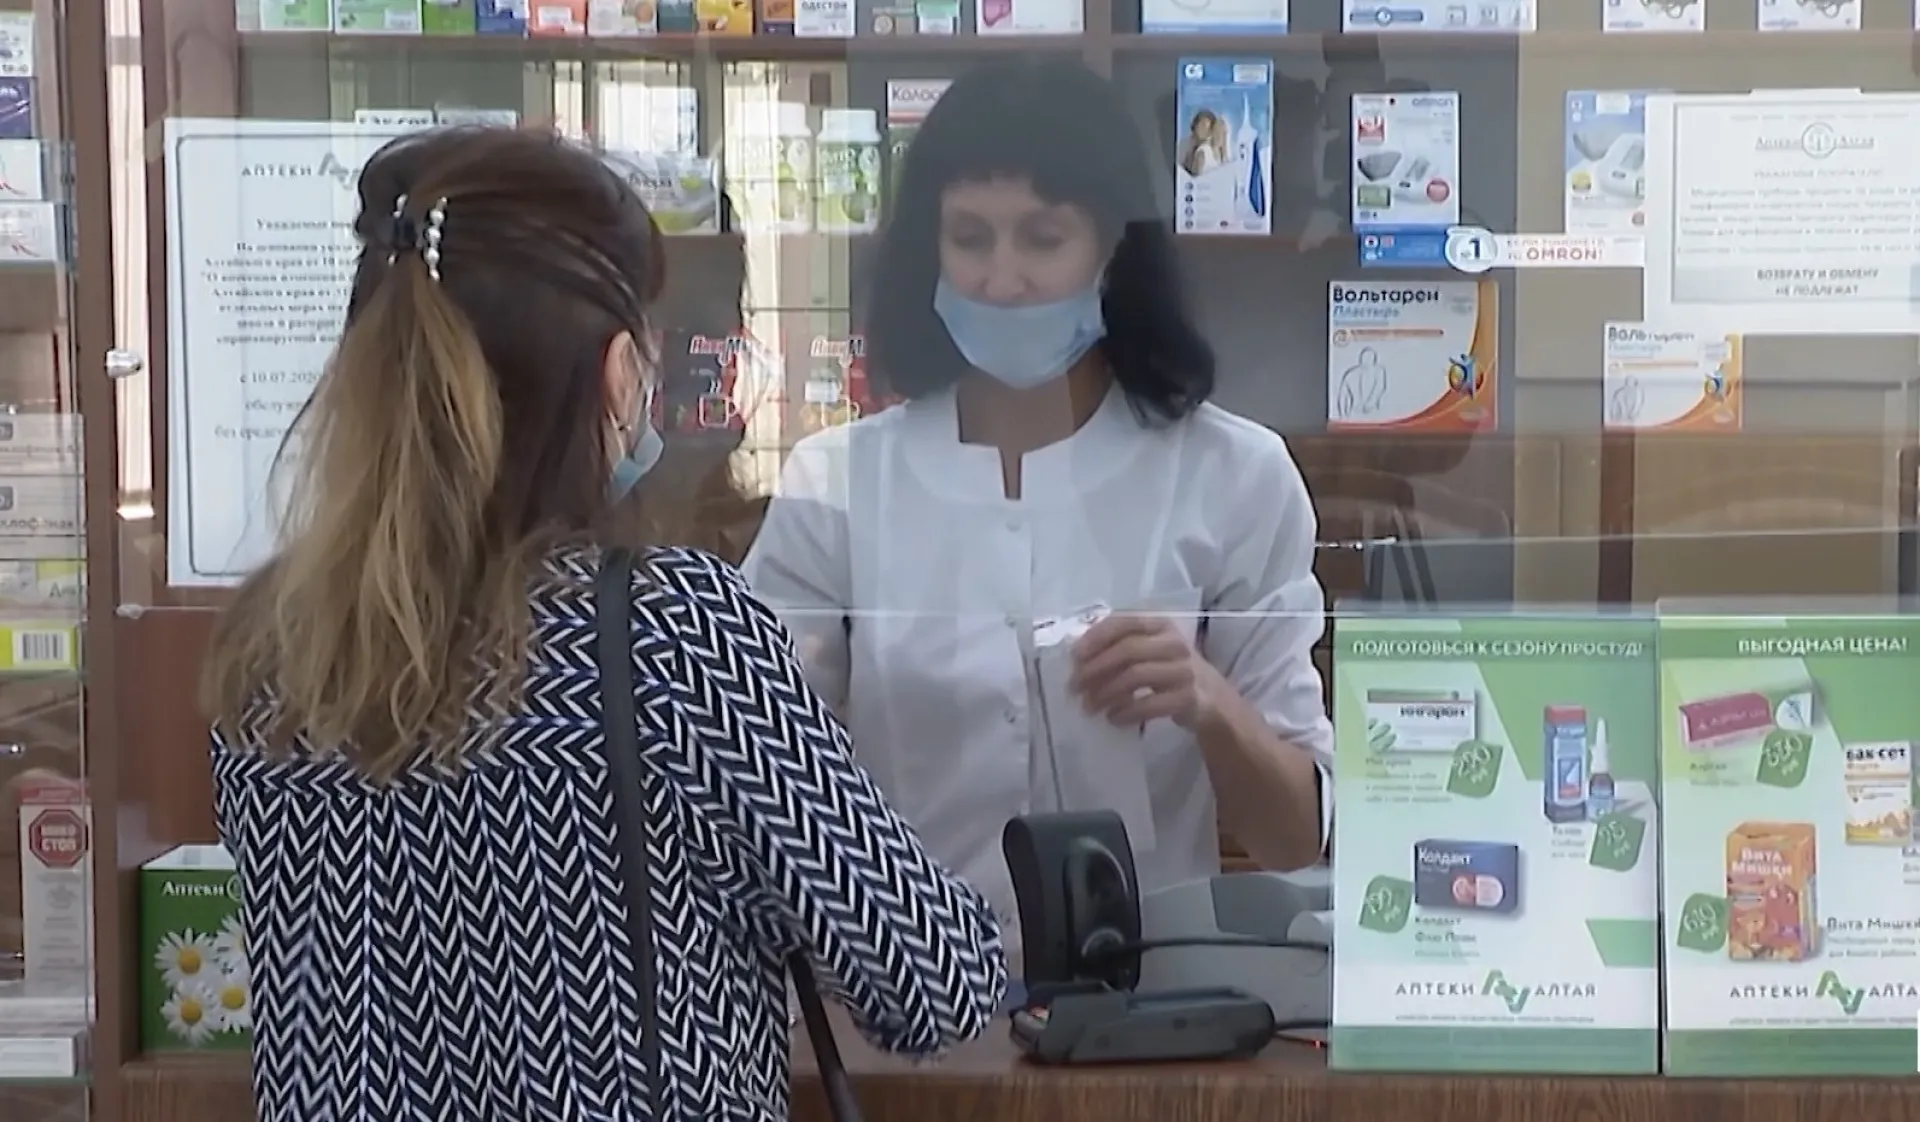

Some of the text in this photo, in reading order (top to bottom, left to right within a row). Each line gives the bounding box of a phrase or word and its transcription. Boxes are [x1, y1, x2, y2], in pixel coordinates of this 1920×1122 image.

[1332, 287, 1439, 306] Вольтарен
[1352, 640, 1644, 657] ПОДГОТОВЬСЯ К СЕЗОНУ ПРОСТУД!
[1738, 636, 1909, 656] ВЫГОДНАЯ ЦЕНА!
[163, 880, 225, 897] Аптеки
[1395, 982, 1597, 998] АПТЕКИ АЛТАЯ
[1730, 985, 1920, 998] АПТЕКИ АЛТА
